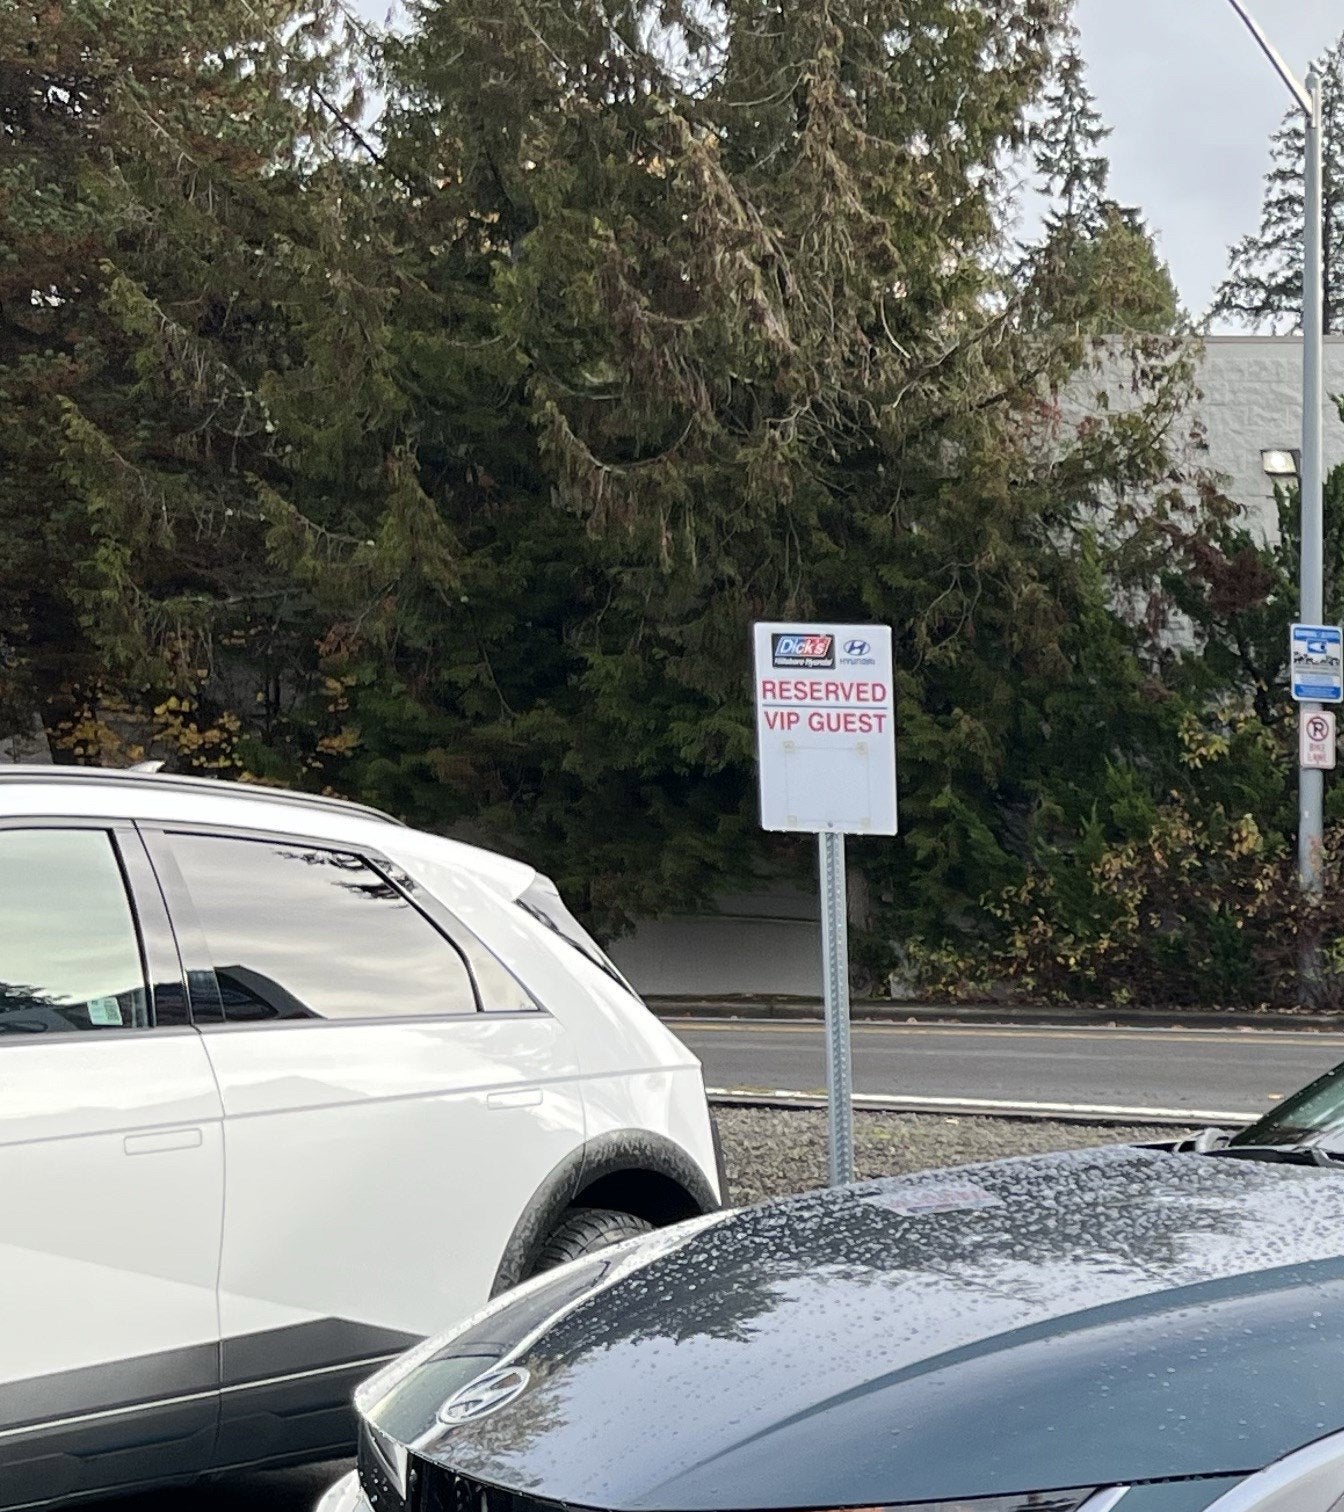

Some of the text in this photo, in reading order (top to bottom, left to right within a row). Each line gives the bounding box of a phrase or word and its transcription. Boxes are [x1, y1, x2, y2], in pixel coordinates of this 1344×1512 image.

[761, 680, 887, 703] RESERVED
[764, 711, 887, 733] VIP GUEST
